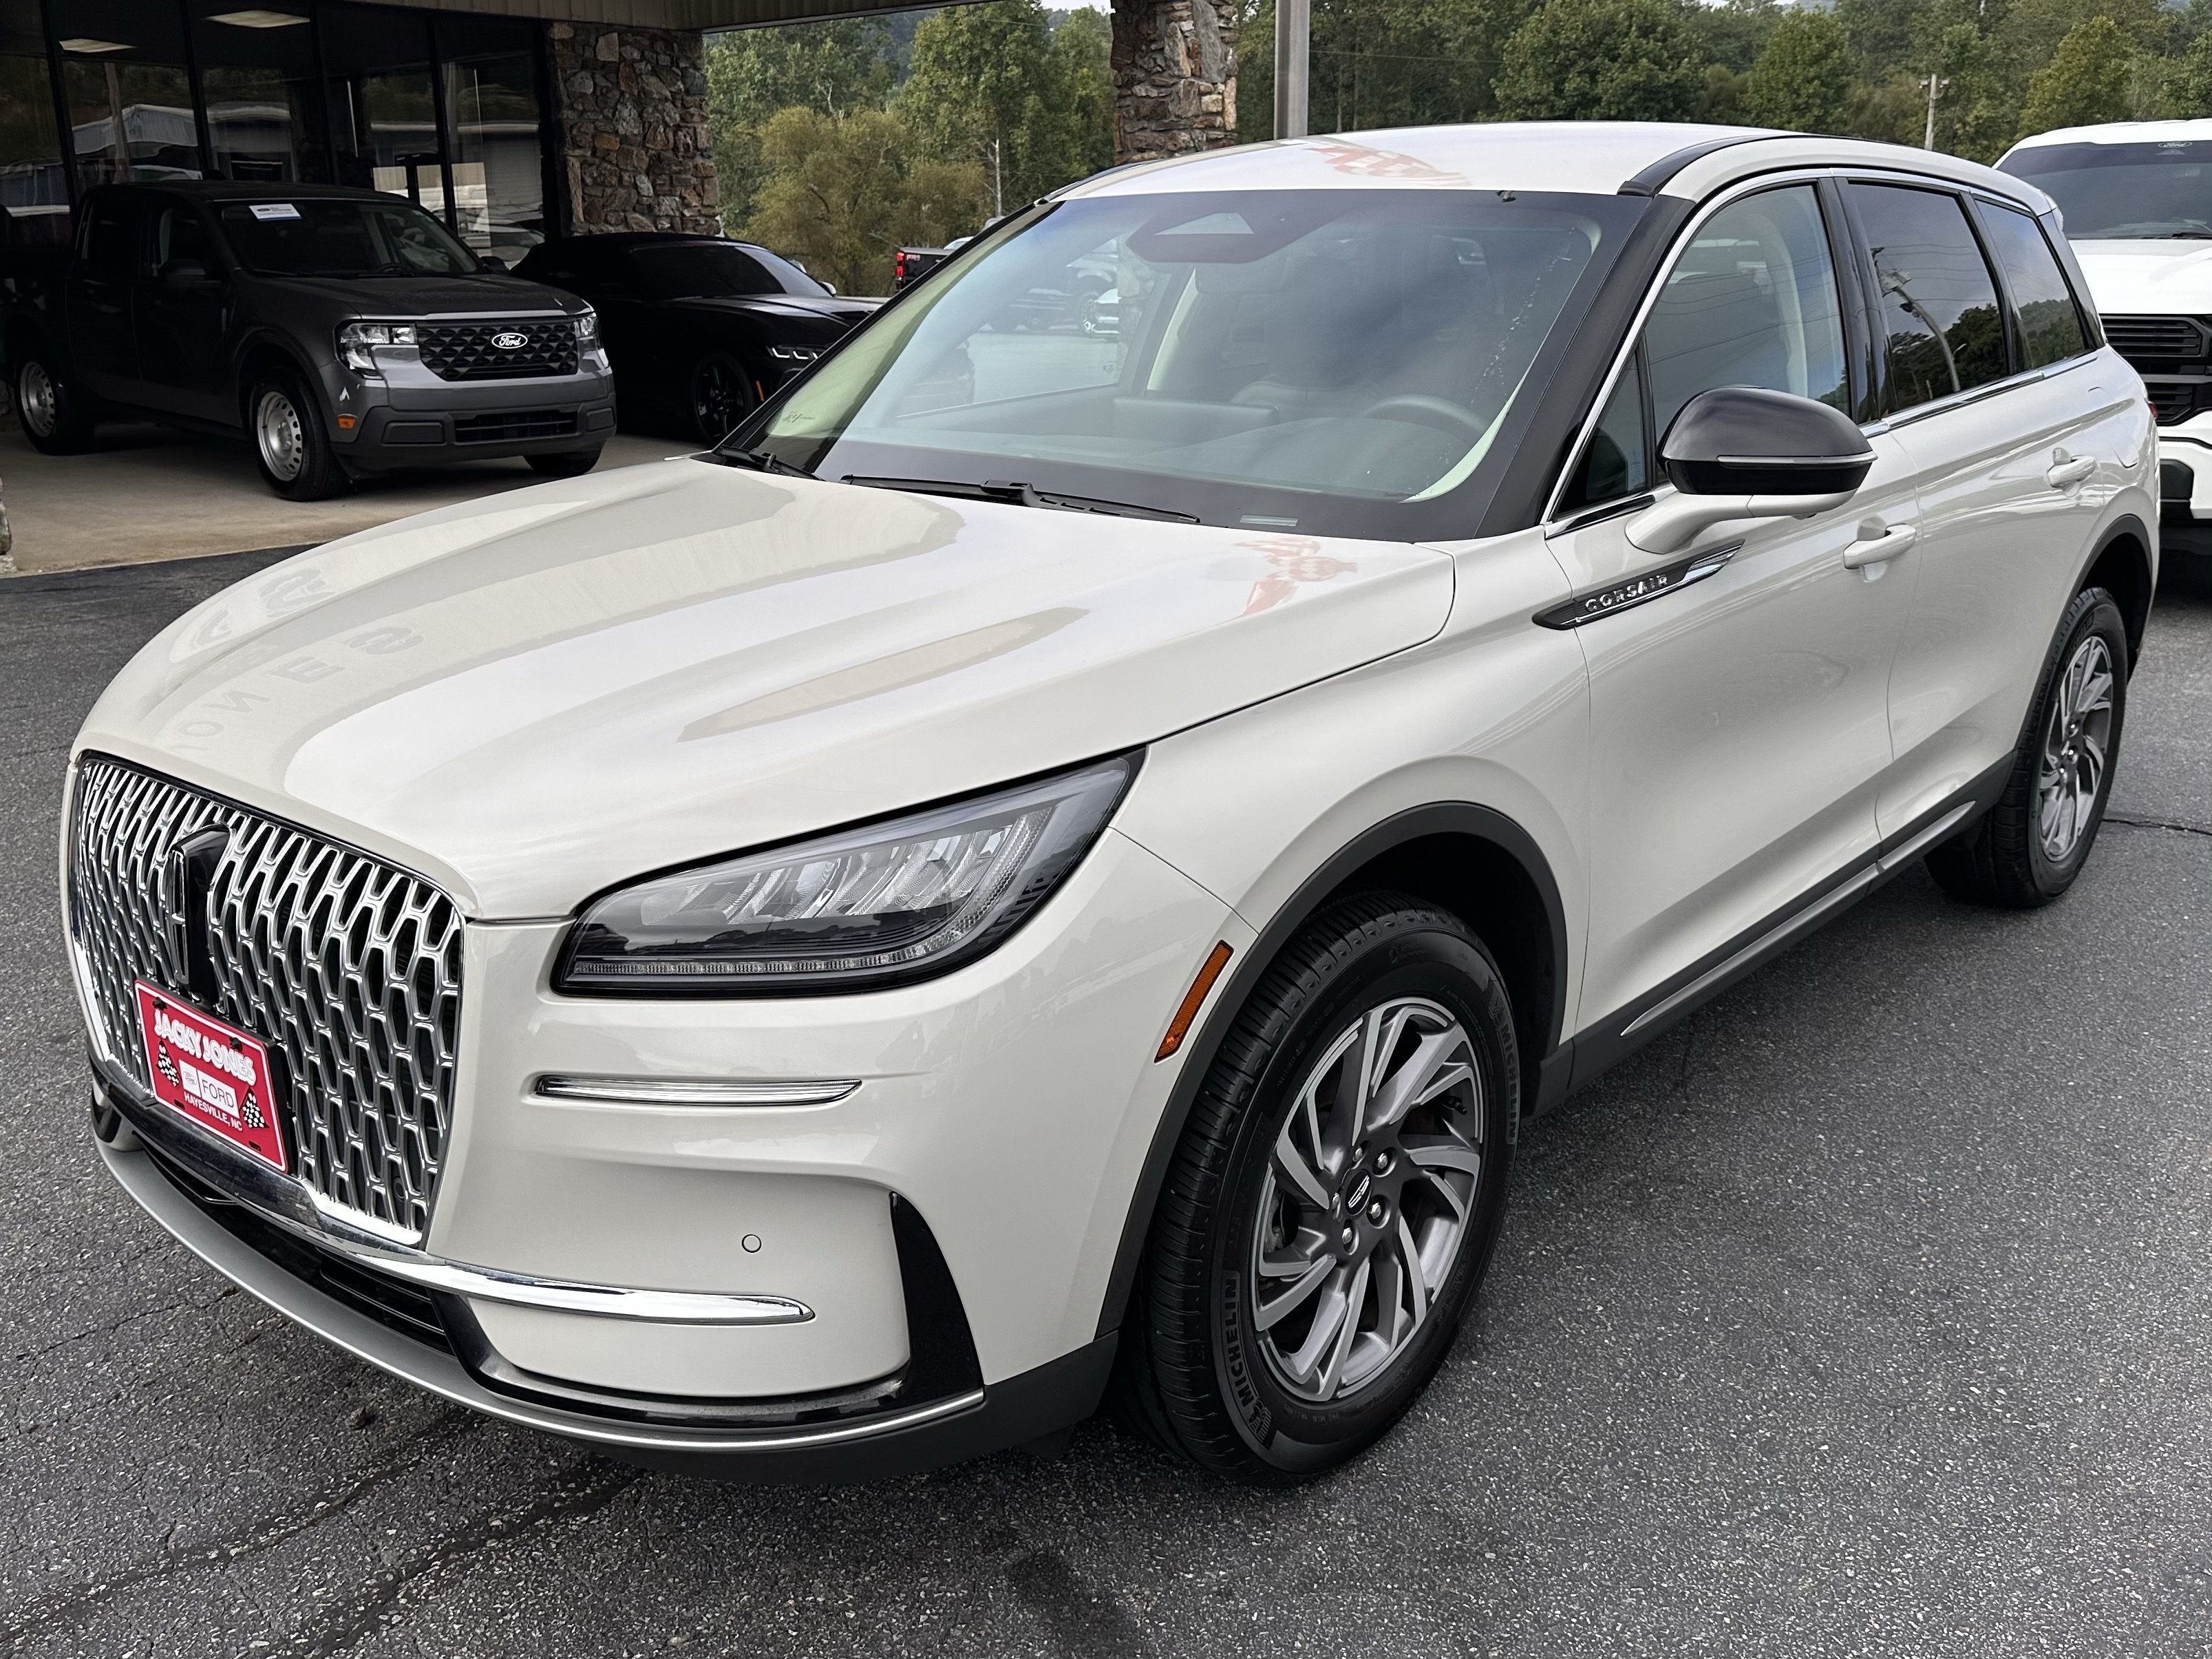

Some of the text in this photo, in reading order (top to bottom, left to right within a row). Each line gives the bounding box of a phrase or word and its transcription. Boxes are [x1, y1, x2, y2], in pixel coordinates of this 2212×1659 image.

[499, 335, 522, 346] Ford
[1585, 573, 1668, 612] CORSAIR
[154, 1009, 257, 1086] JACKY JONES
[202, 1079, 234, 1108] FORD
[1501, 1024, 1518, 1138] MICHELIN
[184, 1092, 242, 1132] HAYESVILLE, NC
[1225, 1278, 1255, 1408] MICHELIN
